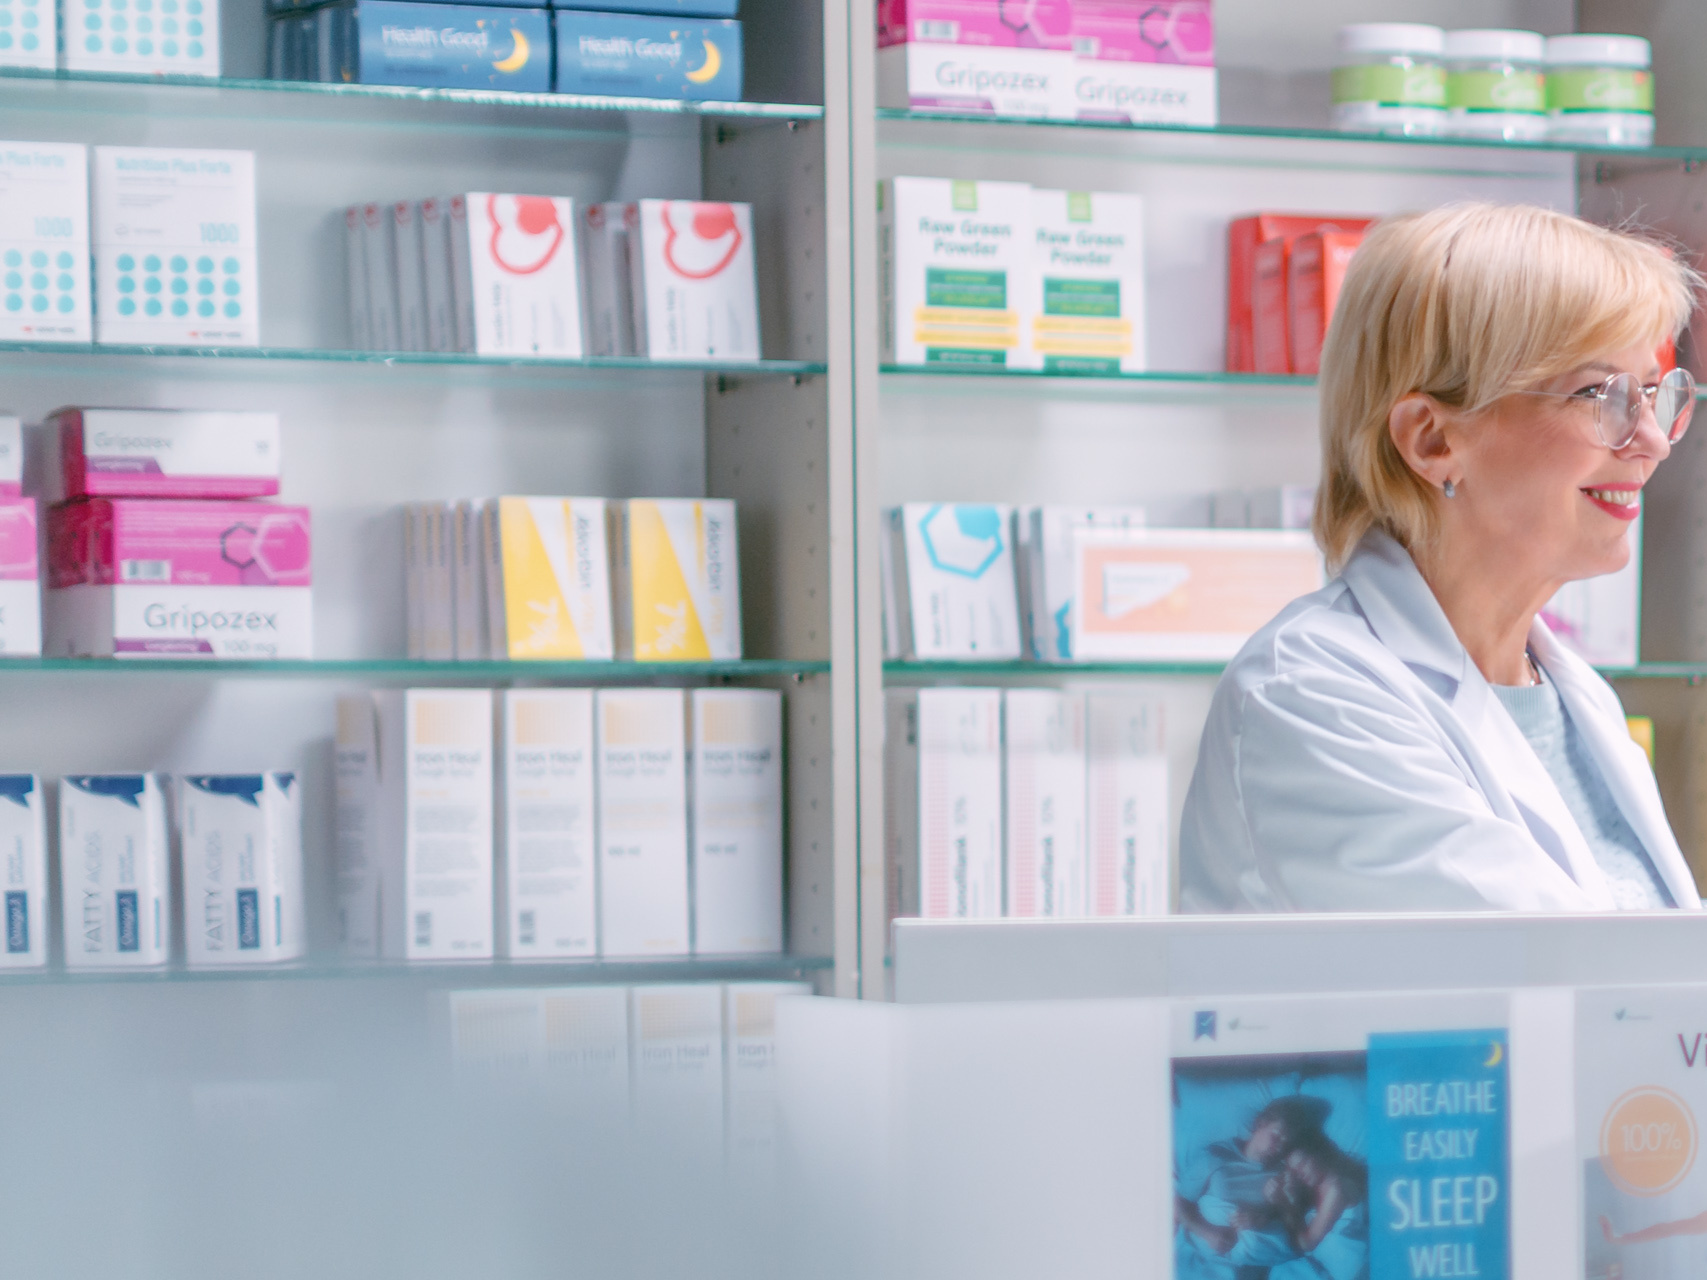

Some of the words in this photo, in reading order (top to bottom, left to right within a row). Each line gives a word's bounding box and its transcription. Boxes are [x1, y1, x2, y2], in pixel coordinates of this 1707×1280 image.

[382, 24, 438, 47] Health
[440, 27, 488, 49] Good
[579, 35, 632, 57] Health
[634, 38, 682, 59] Good
[935, 61, 1049, 93] Gripozex
[1075, 76, 1188, 105] Gripozex
[919, 216, 954, 235] Raw
[960, 219, 1012, 238] Green
[1036, 227, 1071, 245] Raw
[1076, 230, 1124, 248] Green
[934, 238, 999, 257] Powder
[1050, 250, 1112, 266] Powder
[94, 431, 173, 452] Gripozex
[143, 602, 279, 635] Gripozex
[82, 887, 102, 953] FATTY
[205, 887, 225, 953] FATTY
[642, 1044, 672, 1060] Iron
[676, 1042, 710, 1058] Heal
[737, 1041, 765, 1058] Iron
[1385, 1079, 1497, 1118] BREATHE
[1404, 1129, 1479, 1162] EASILY
[1620, 1122, 1682, 1152] 100%
[1388, 1175, 1498, 1230] SLEEP
[1409, 1243, 1480, 1278] WELL
